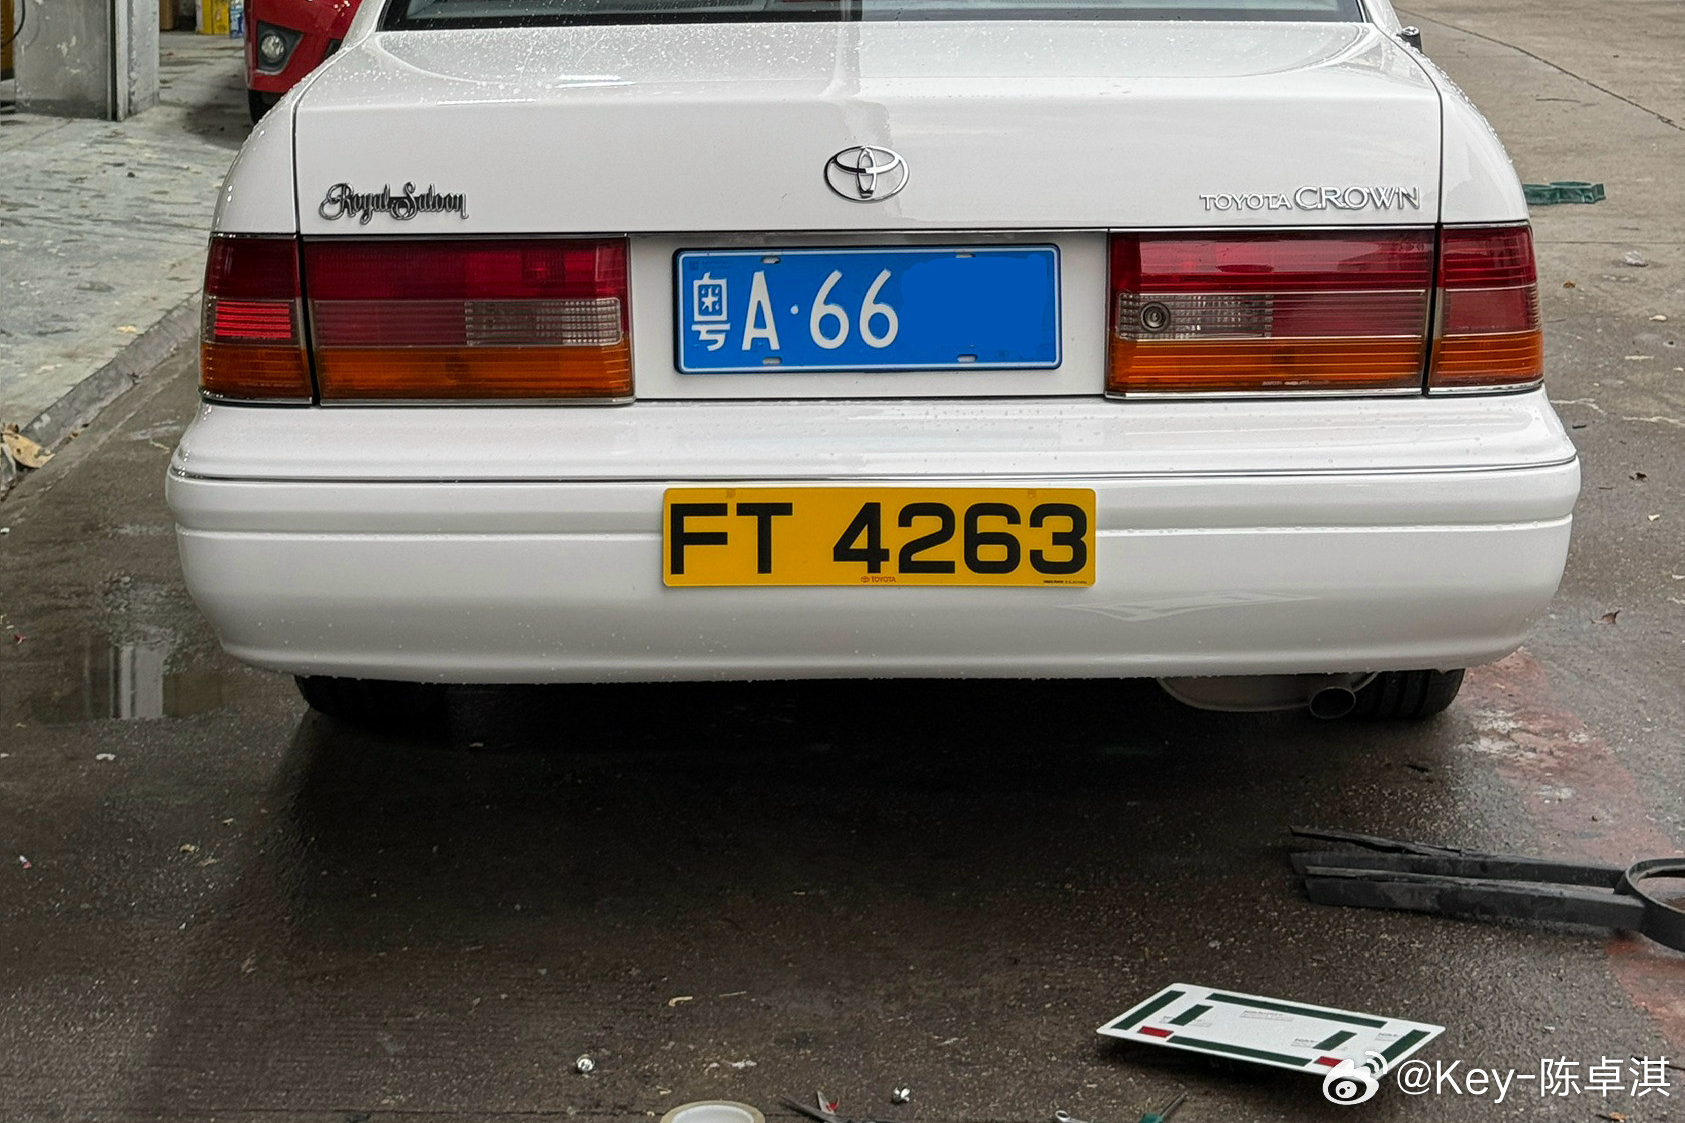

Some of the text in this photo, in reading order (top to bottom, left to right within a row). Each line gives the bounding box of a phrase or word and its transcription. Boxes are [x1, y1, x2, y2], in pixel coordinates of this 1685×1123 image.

[319, 181, 469, 225] Royal Saloon
[1200, 186, 1420, 211] TOYOTA CROWN
[670, 502, 1088, 574] FT 4263
